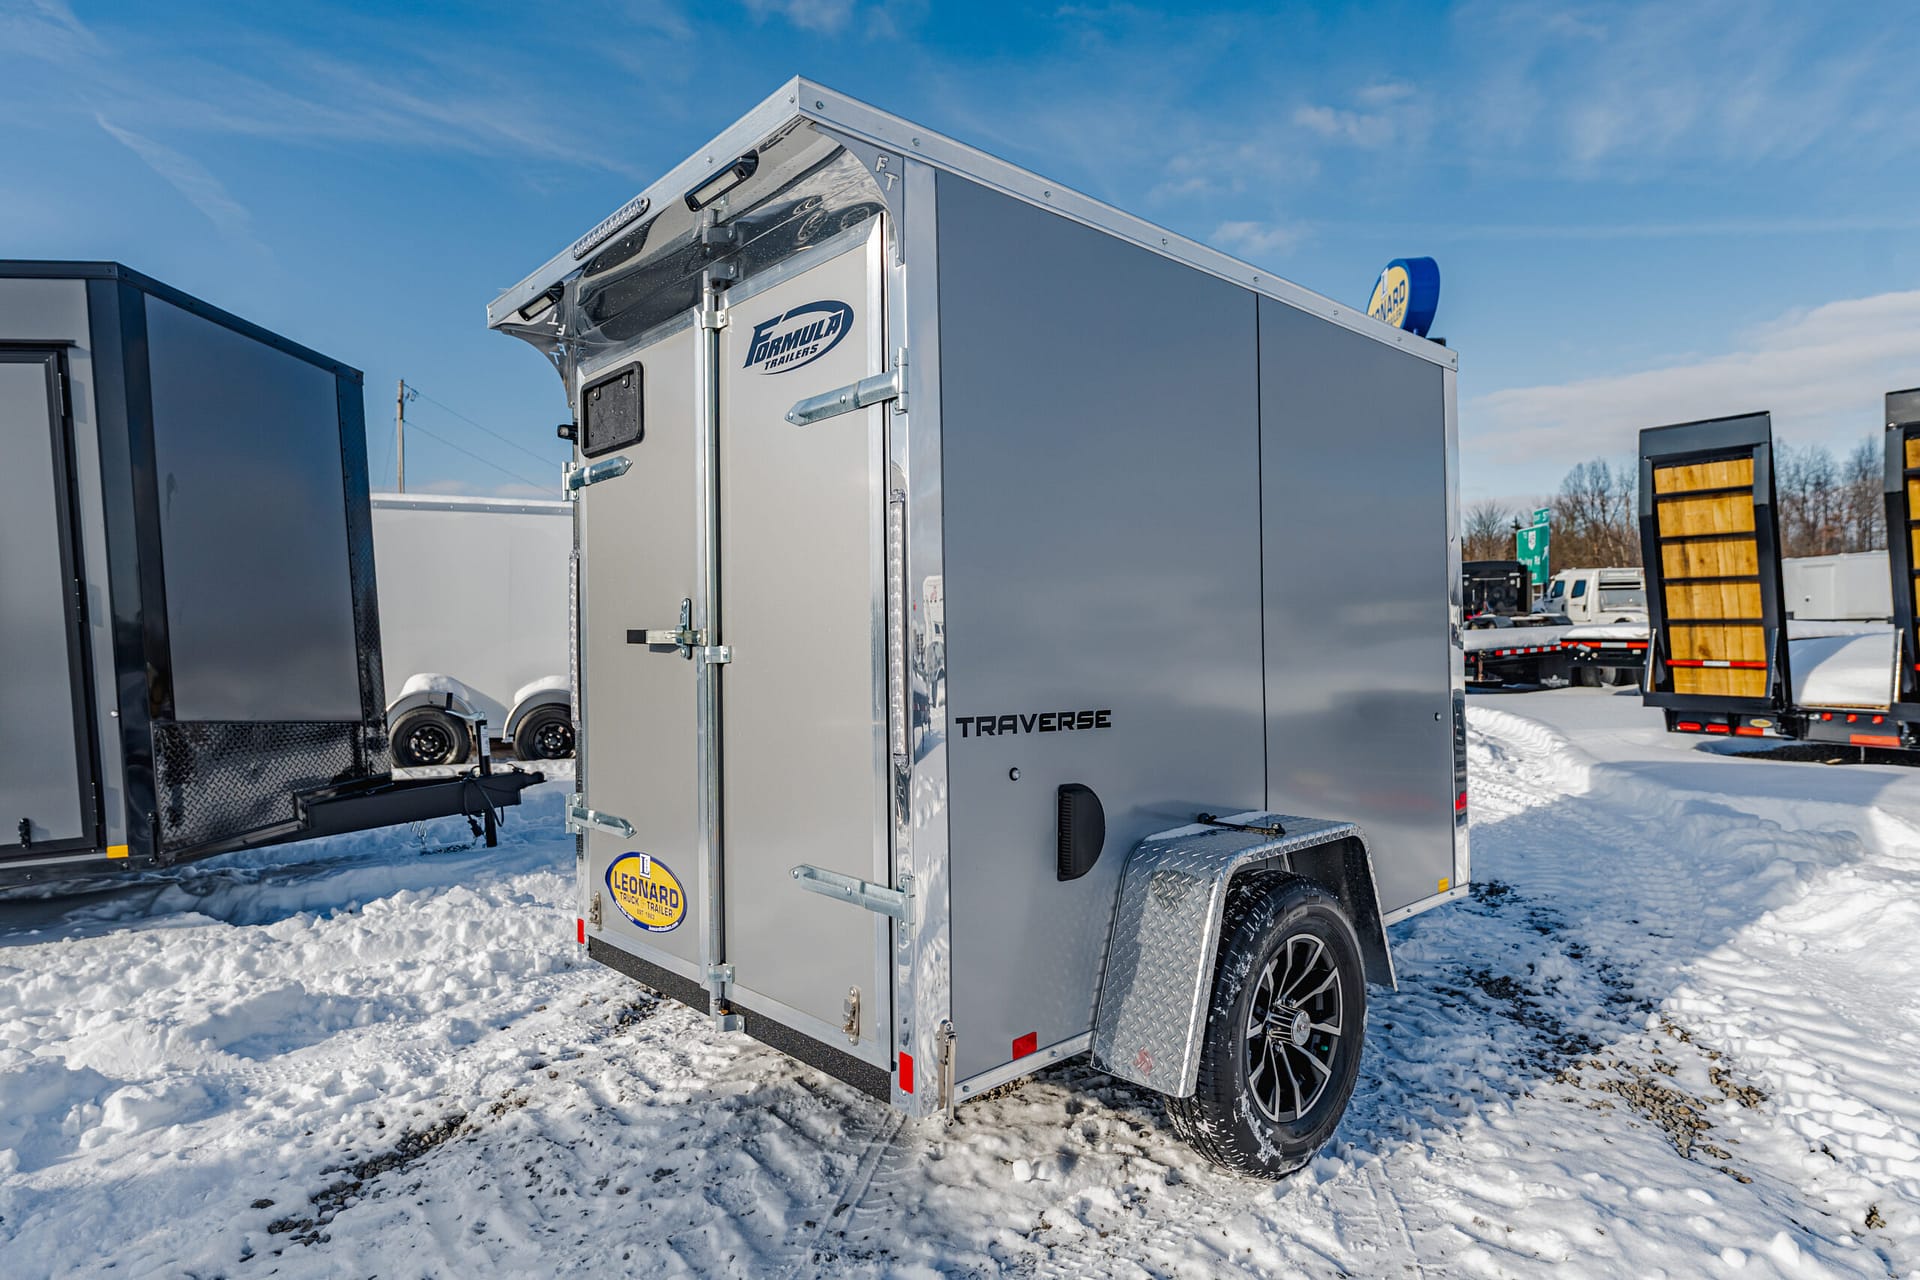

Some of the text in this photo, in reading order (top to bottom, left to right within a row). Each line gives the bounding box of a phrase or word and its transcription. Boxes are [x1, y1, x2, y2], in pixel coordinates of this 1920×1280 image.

[742, 310, 844, 369] FORMULA
[764, 343, 819, 370] TRAILERS
[955, 709, 1112, 738] TRAVERSE
[614, 870, 679, 909] LEONARD
[647, 901, 673, 918] TRAILER
